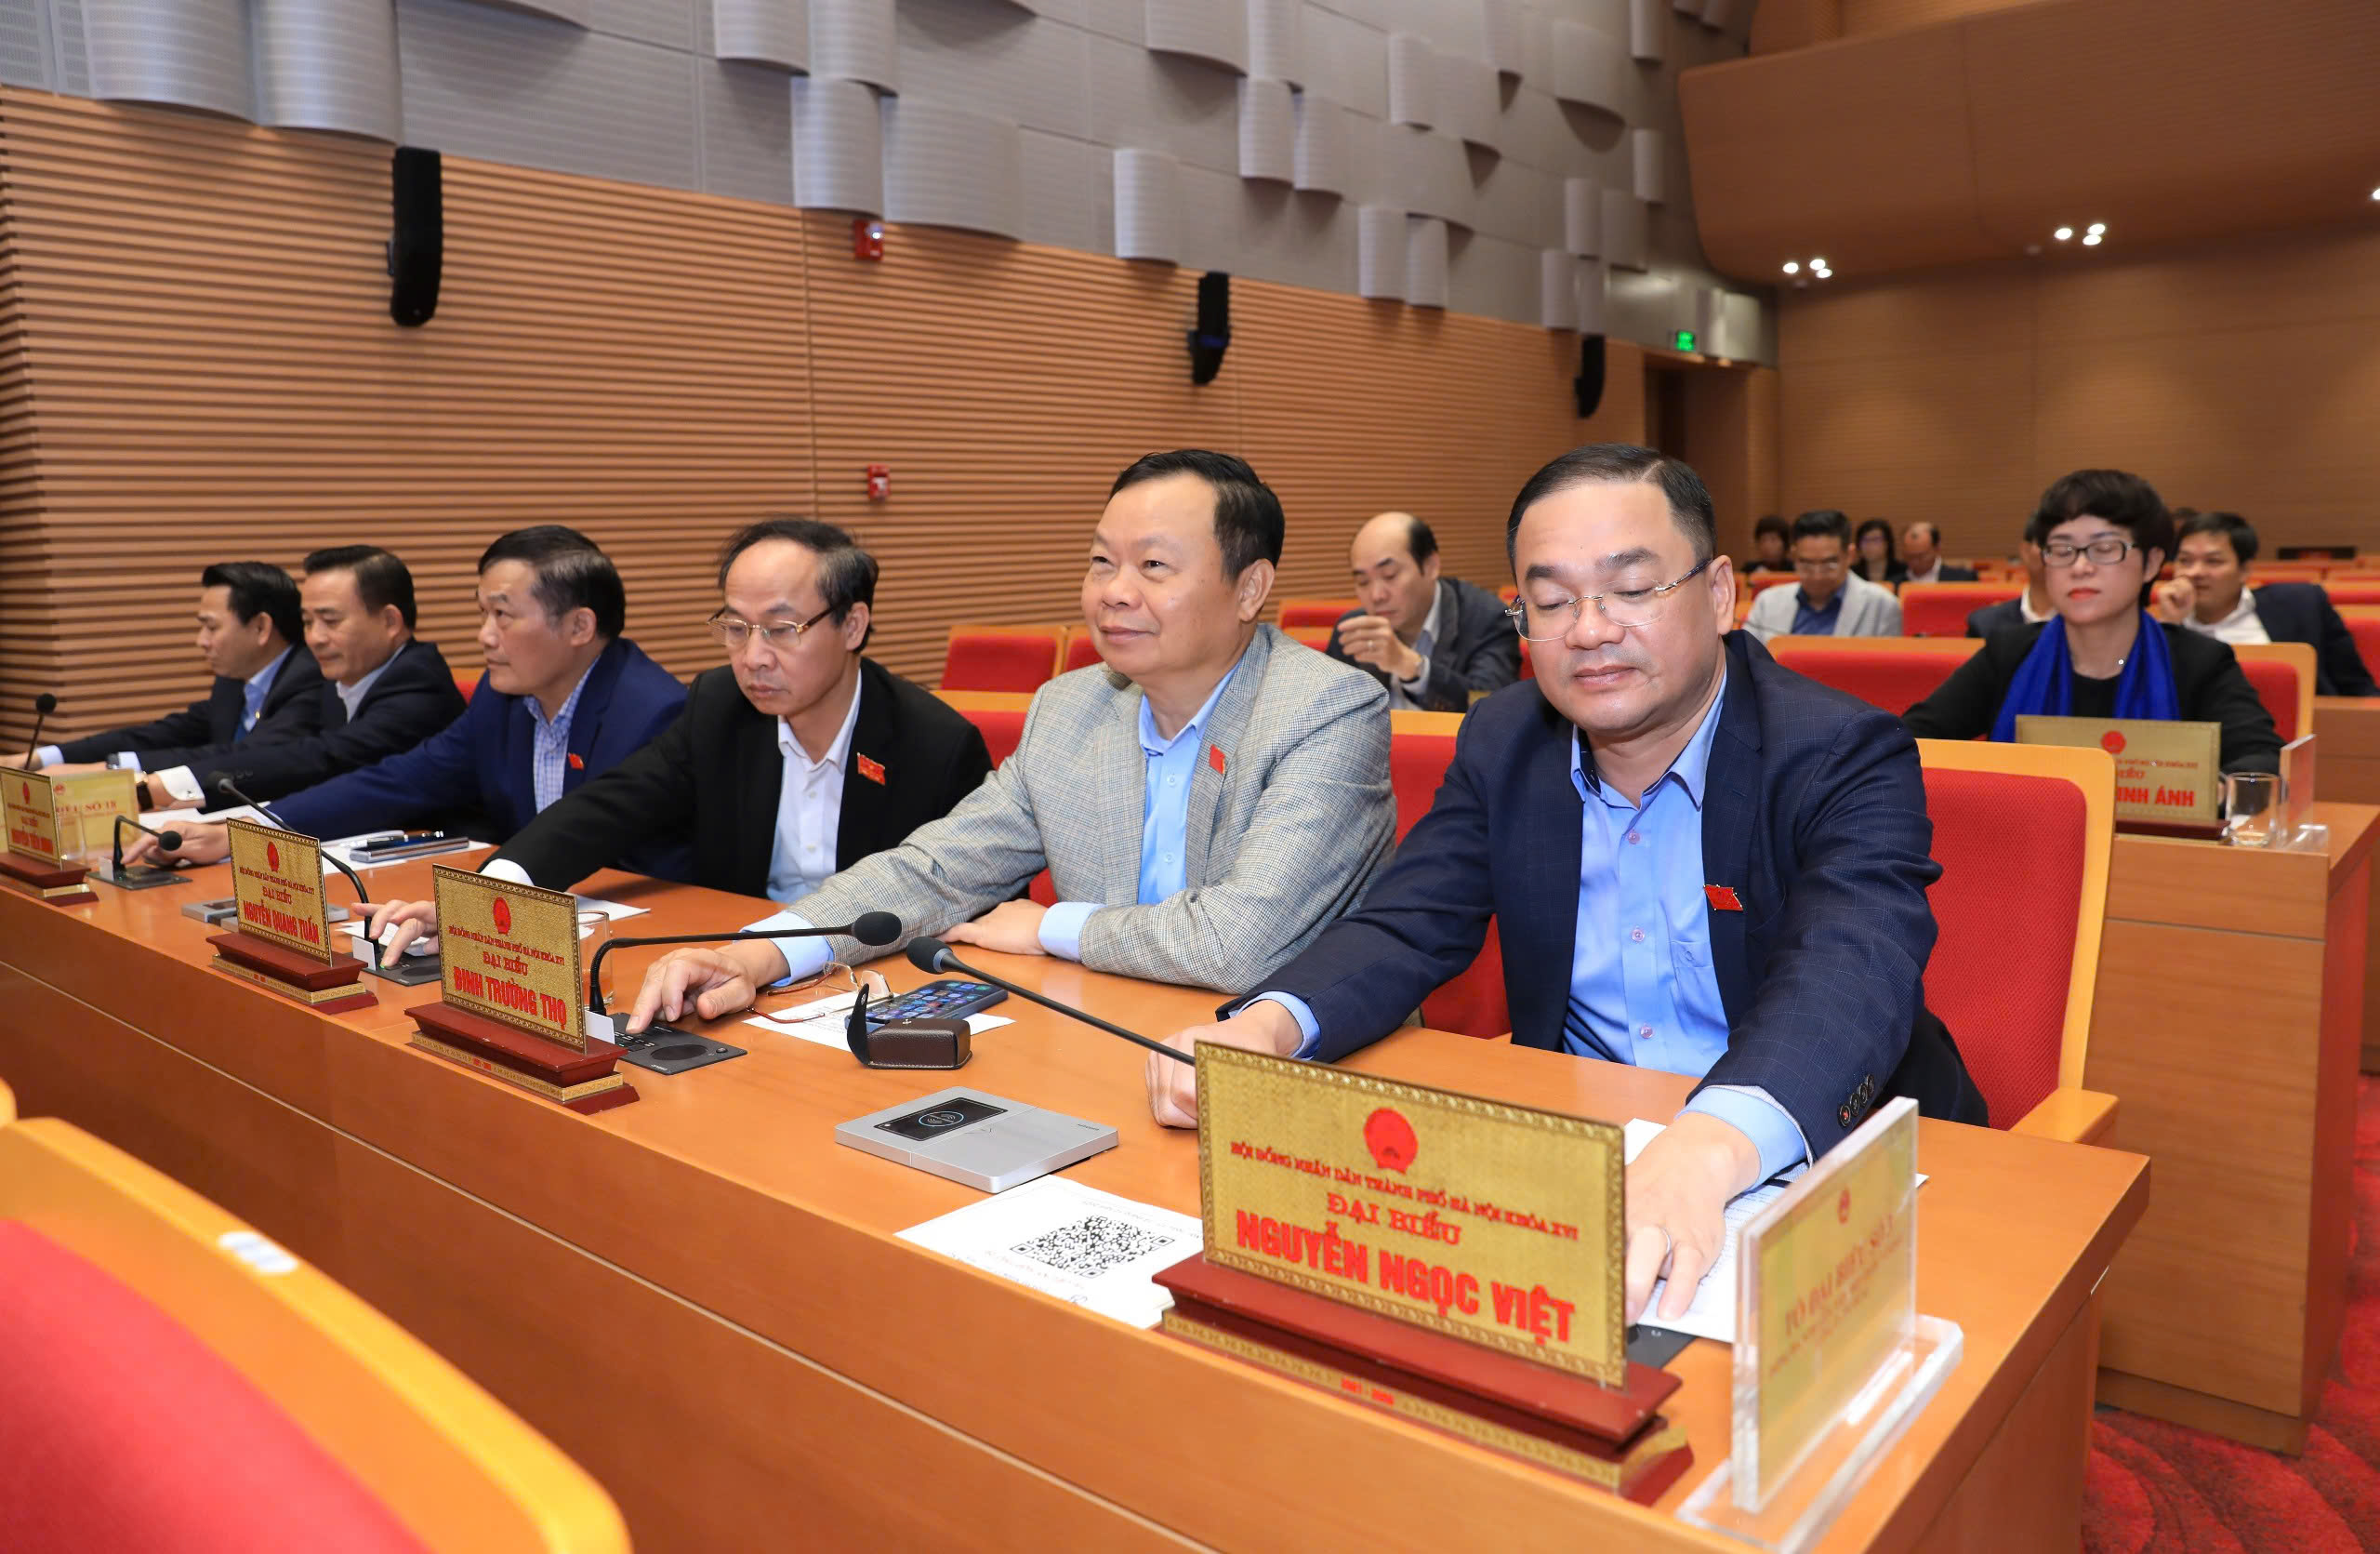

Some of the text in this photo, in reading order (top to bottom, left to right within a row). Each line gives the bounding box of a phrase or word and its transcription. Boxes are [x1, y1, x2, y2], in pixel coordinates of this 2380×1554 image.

[2116, 785, 2195, 807] INH ÁNH
[262, 885, 291, 905] ĐẠI BIỂU
[243, 899, 320, 945] NGUYỄN QUANG TUẤN
[483, 951, 529, 976] ĐẠI BIỂU
[453, 966, 566, 1031] ĐINH TRƯỜNG THỌ
[1231, 1140, 1580, 1242] HỘI ĐỒNG NHÂN DÂN THÀNH PHỐ HÀ NỘI KHÓA XVI
[1327, 1191, 1461, 1246] ĐẠI BIỂU
[1236, 1208, 1368, 1285] NGUYỄN
[1379, 1249, 1480, 1318] NGỌC
[1490, 1281, 1576, 1347] VIỆT
